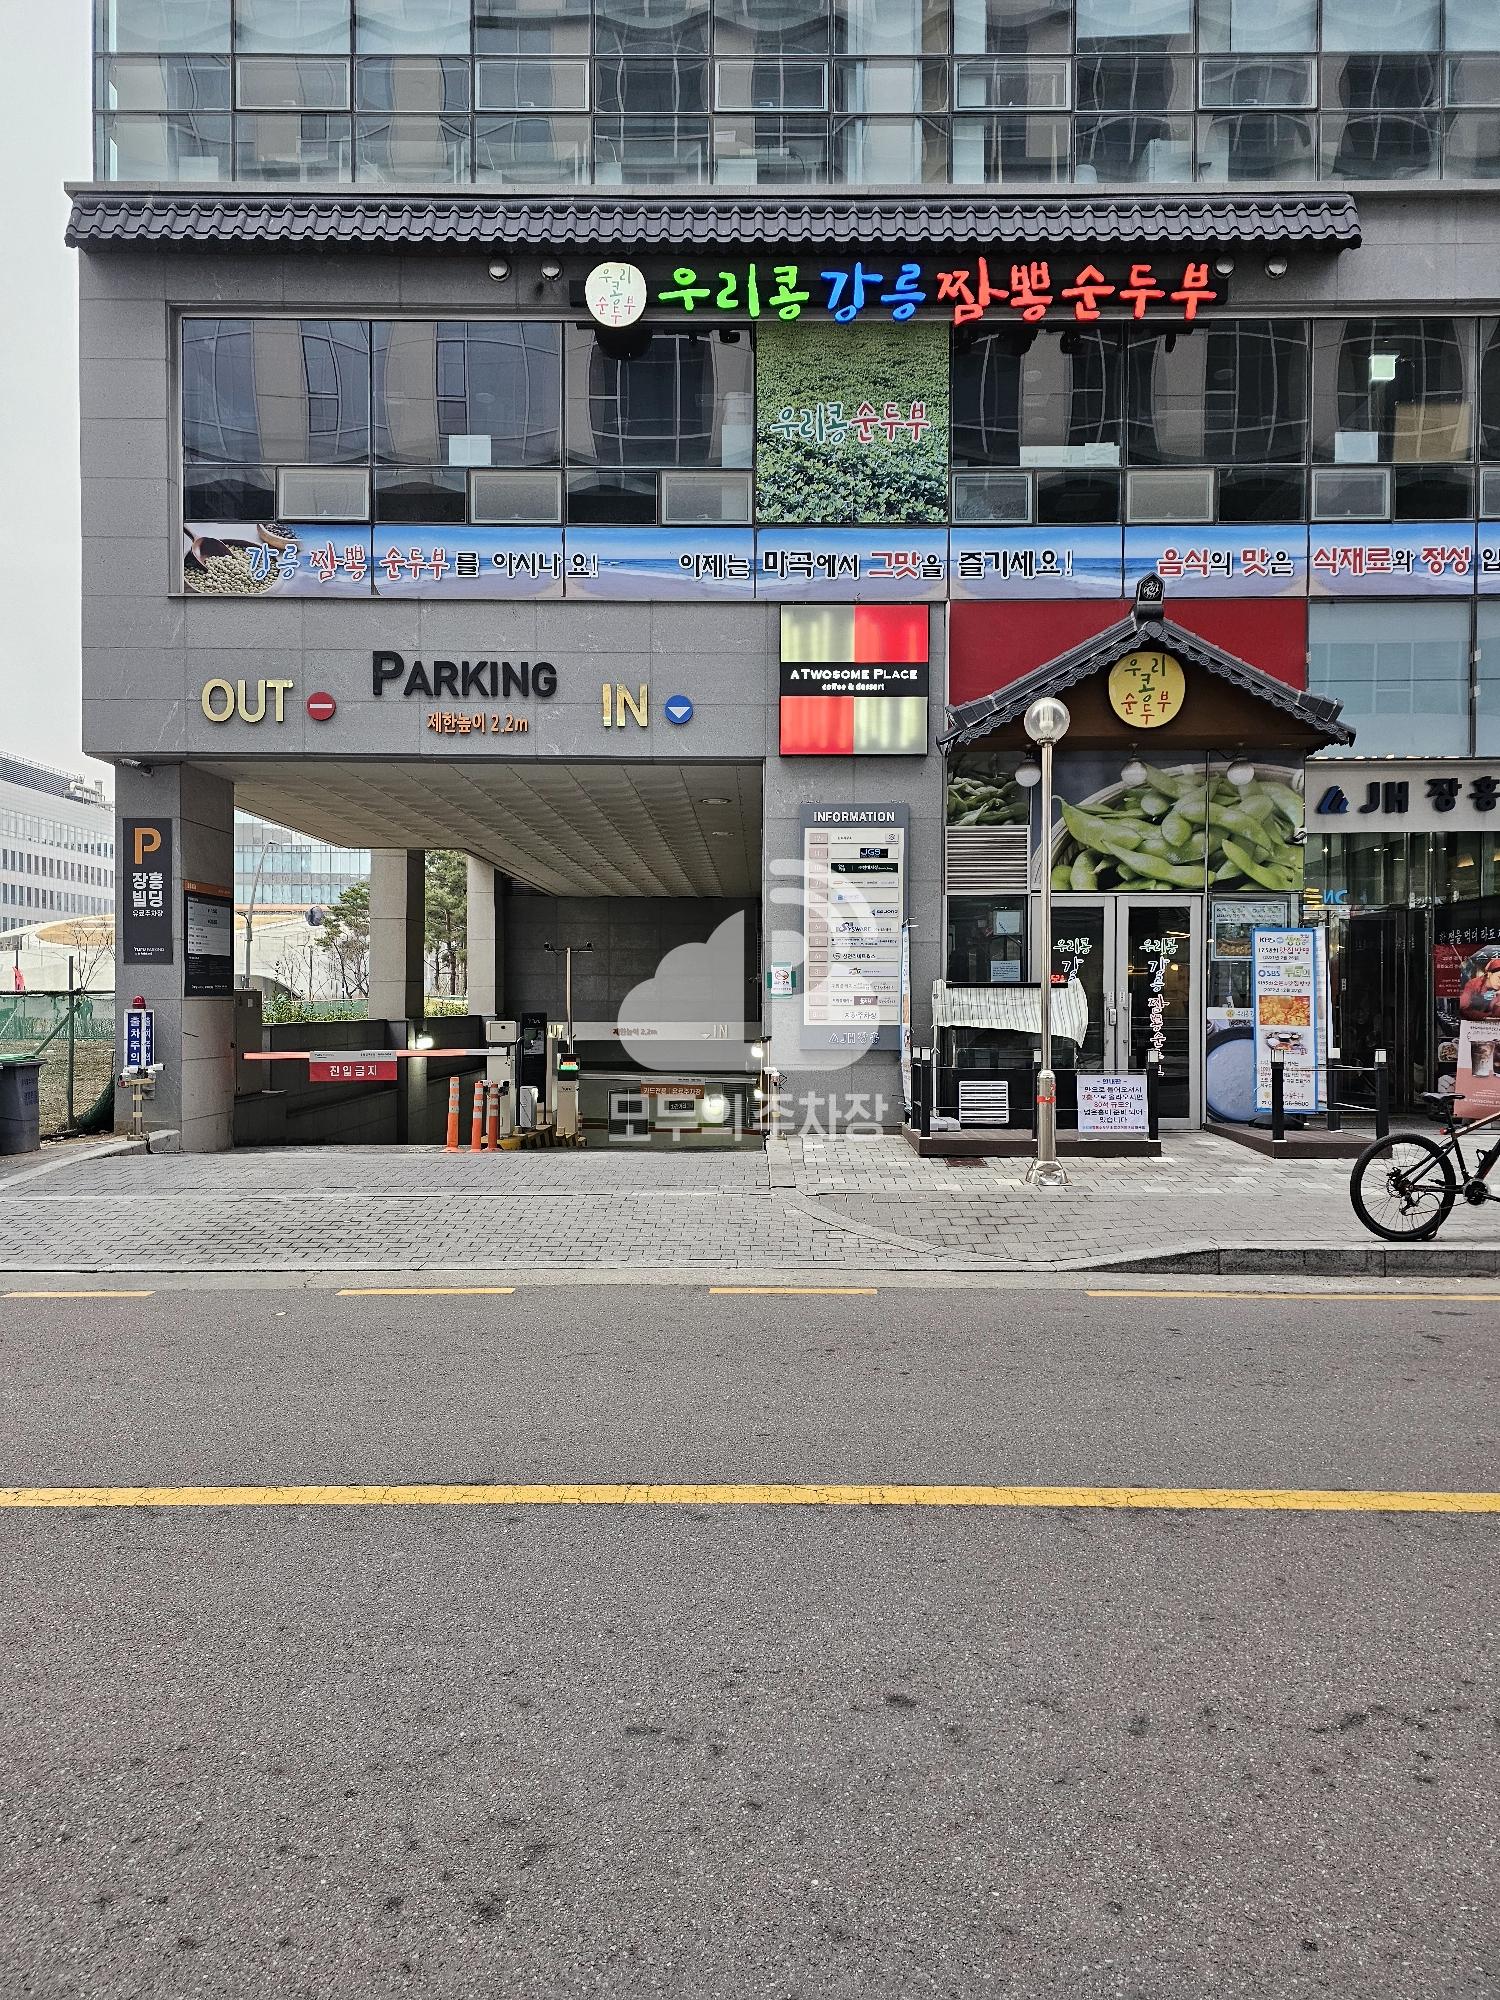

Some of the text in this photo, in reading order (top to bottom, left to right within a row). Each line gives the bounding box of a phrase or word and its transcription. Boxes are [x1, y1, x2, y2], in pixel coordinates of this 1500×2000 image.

[657, 262, 811, 322] 우리콩
[819, 261, 928, 325] 강릉
[595, 295, 637, 325] 순두부
[246, 543, 300, 581] 강릉
[309, 542, 367, 583] 짬뽕
[379, 546, 480, 581] 순두부를
[678, 549, 751, 581] 이제는
[761, 549, 860, 580] 마곡에서
[867, 550, 945, 581] 그맛을
[957, 549, 1074, 580] 즐기세요!
[1156, 548, 1233, 578] 음식의
[1240, 546, 1295, 578] 맛은
[1312, 546, 1415, 578] 식재료와
[1419, 546, 1472, 576] 정성
[371, 650, 558, 699] PARKING
[200, 678, 294, 723] OUT
[601, 683, 649, 728] IN
[1120, 691, 1172, 726] 순두부
[426, 711, 530, 734] 제한높이 2.2m
[1359, 781, 1410, 814] JH
[813, 811, 896, 823] INFORMATION
[133, 827, 162, 865] P
[132, 871, 164, 890] 장흥
[132, 890, 163, 908] 빌딩
[132, 909, 164, 917] 유료주차장
[1052, 937, 1093, 955] 우리콩
[1138, 937, 1179, 955] 우리콩
[130, 1016, 141, 1063] 출차주의
[713, 1024, 729, 1040] IN
[329, 1064, 377, 1078] 진입금지
